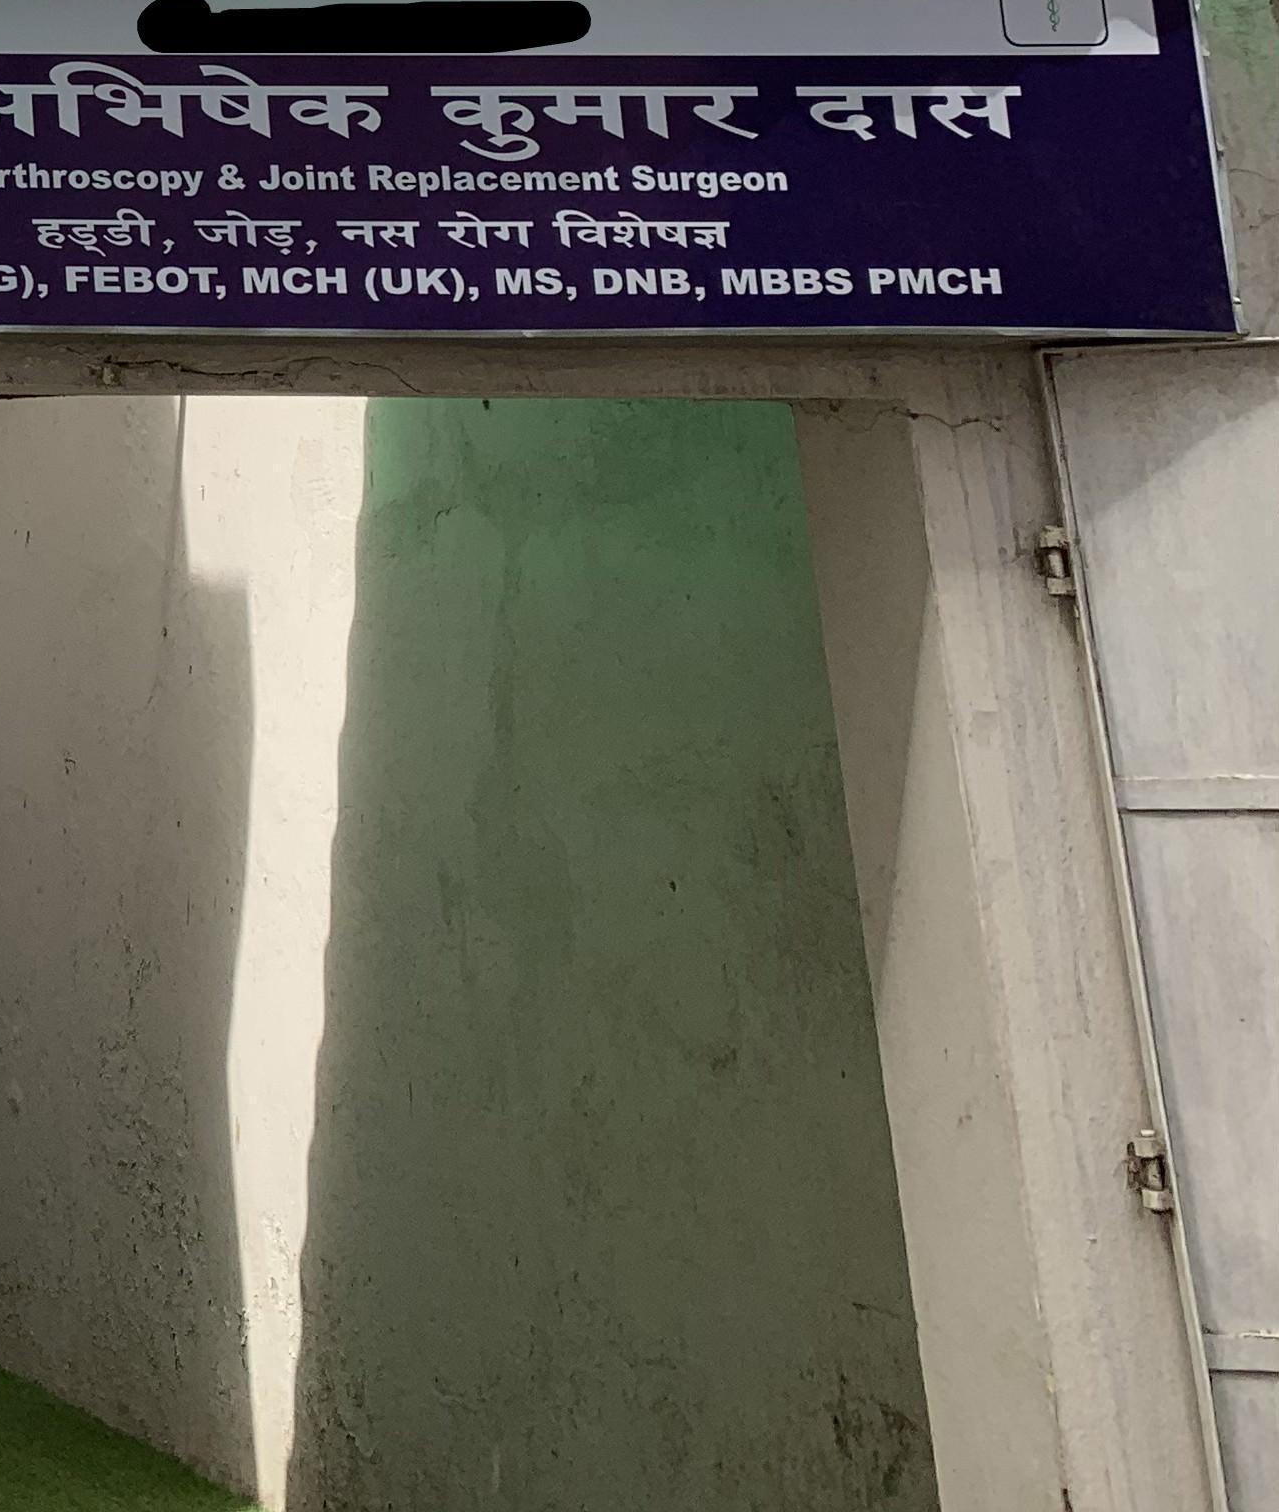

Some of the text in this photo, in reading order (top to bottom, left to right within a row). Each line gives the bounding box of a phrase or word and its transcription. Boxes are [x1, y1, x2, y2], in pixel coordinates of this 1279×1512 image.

[431, 86, 758, 161] कुमार
[796, 86, 1021, 140] दास
[218, 164, 245, 189] &
[259, 165, 355, 190] Joint
[368, 165, 620, 197] Replacement
[632, 165, 787, 198] Surgeon
[337, 220, 419, 248] नस
[438, 211, 533, 248] रोग
[552, 210, 730, 250] विशेषज्ञ
[66, 265, 227, 300] FEBOT,
[243, 267, 348, 294] MCH
[365, 268, 479, 303] (UK),
[496, 268, 577, 302] MS,
[593, 268, 706, 302] DNB,
[721, 268, 854, 295] MBBS
[868, 268, 1003, 295] PMCH
